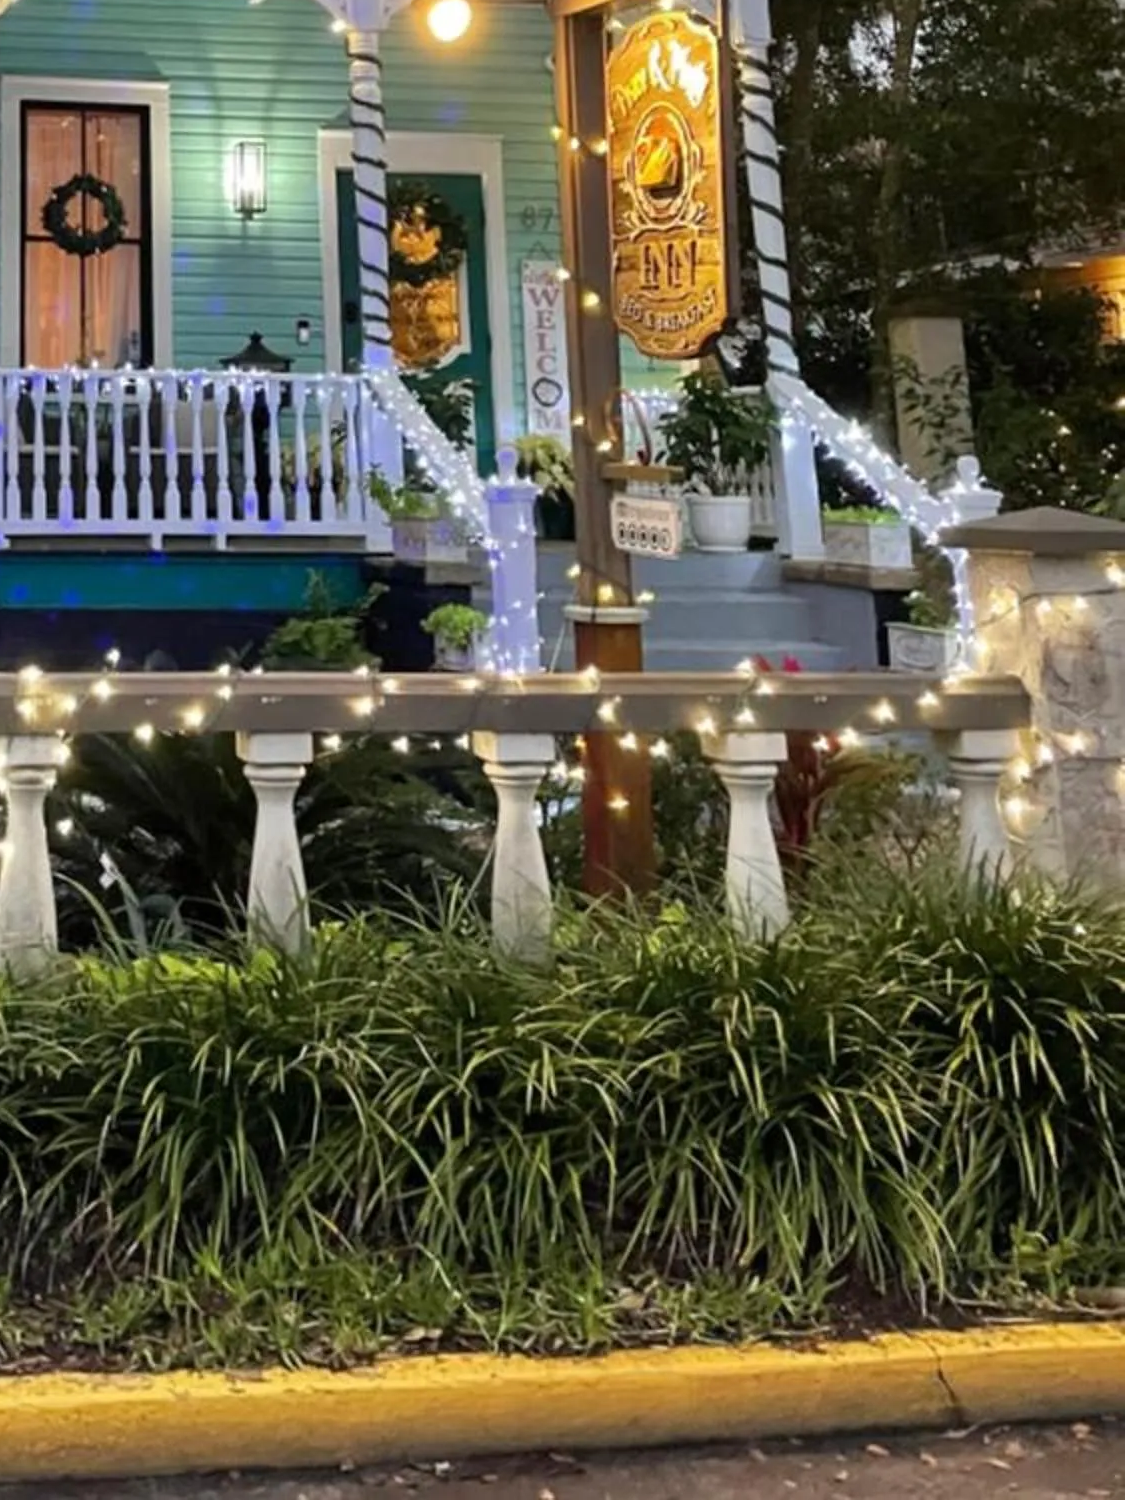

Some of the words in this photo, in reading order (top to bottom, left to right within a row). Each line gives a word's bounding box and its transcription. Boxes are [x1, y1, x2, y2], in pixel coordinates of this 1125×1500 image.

[520, 205, 554, 231] 87
[639, 240, 697, 291] INN
[526, 287, 566, 431] WELCOM
